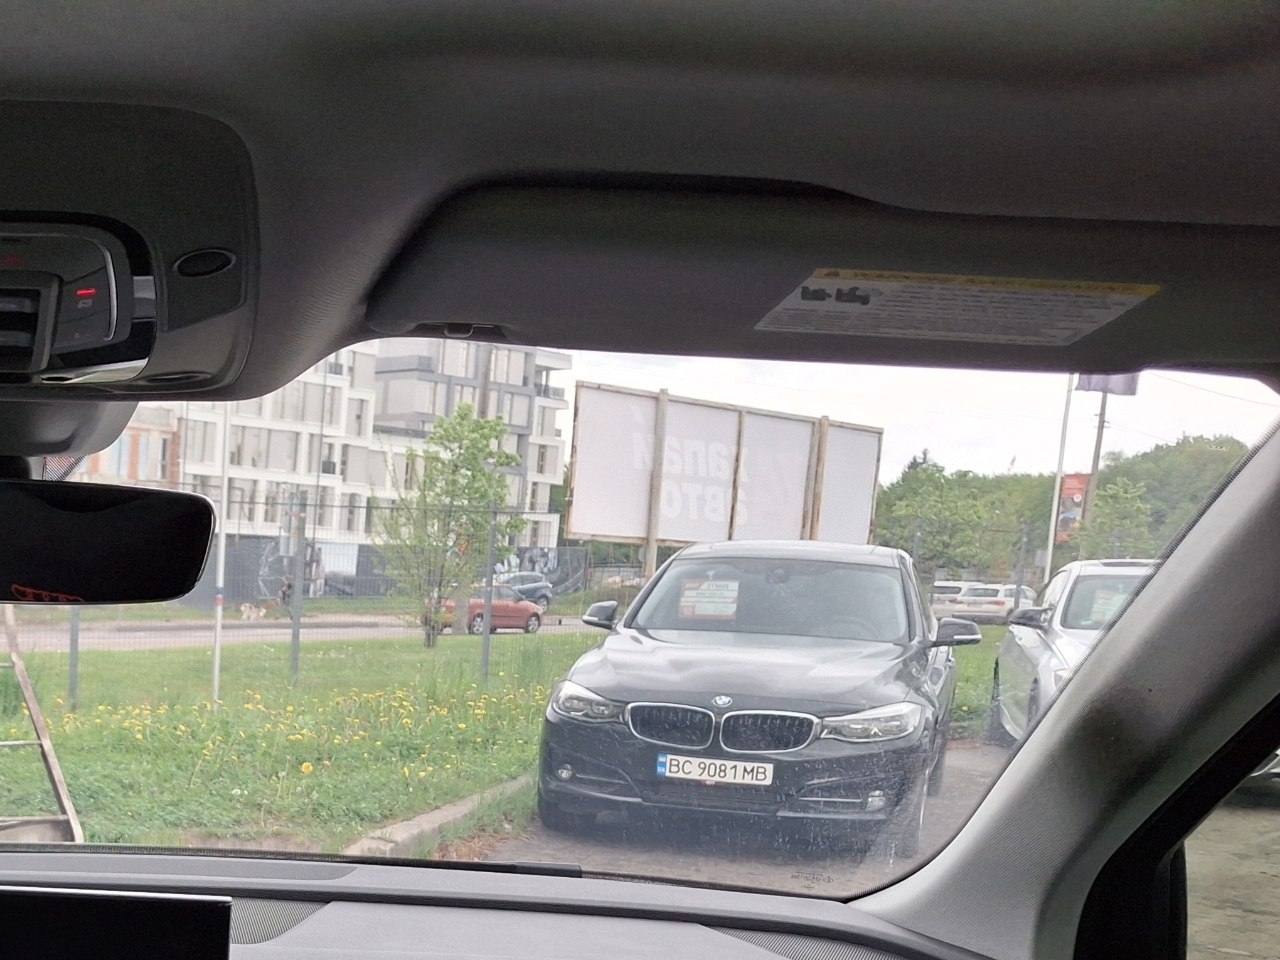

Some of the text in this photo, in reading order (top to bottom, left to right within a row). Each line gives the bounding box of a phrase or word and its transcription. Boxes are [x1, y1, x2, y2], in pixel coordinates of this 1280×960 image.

[668, 758, 767, 782] BC 9081 MB
